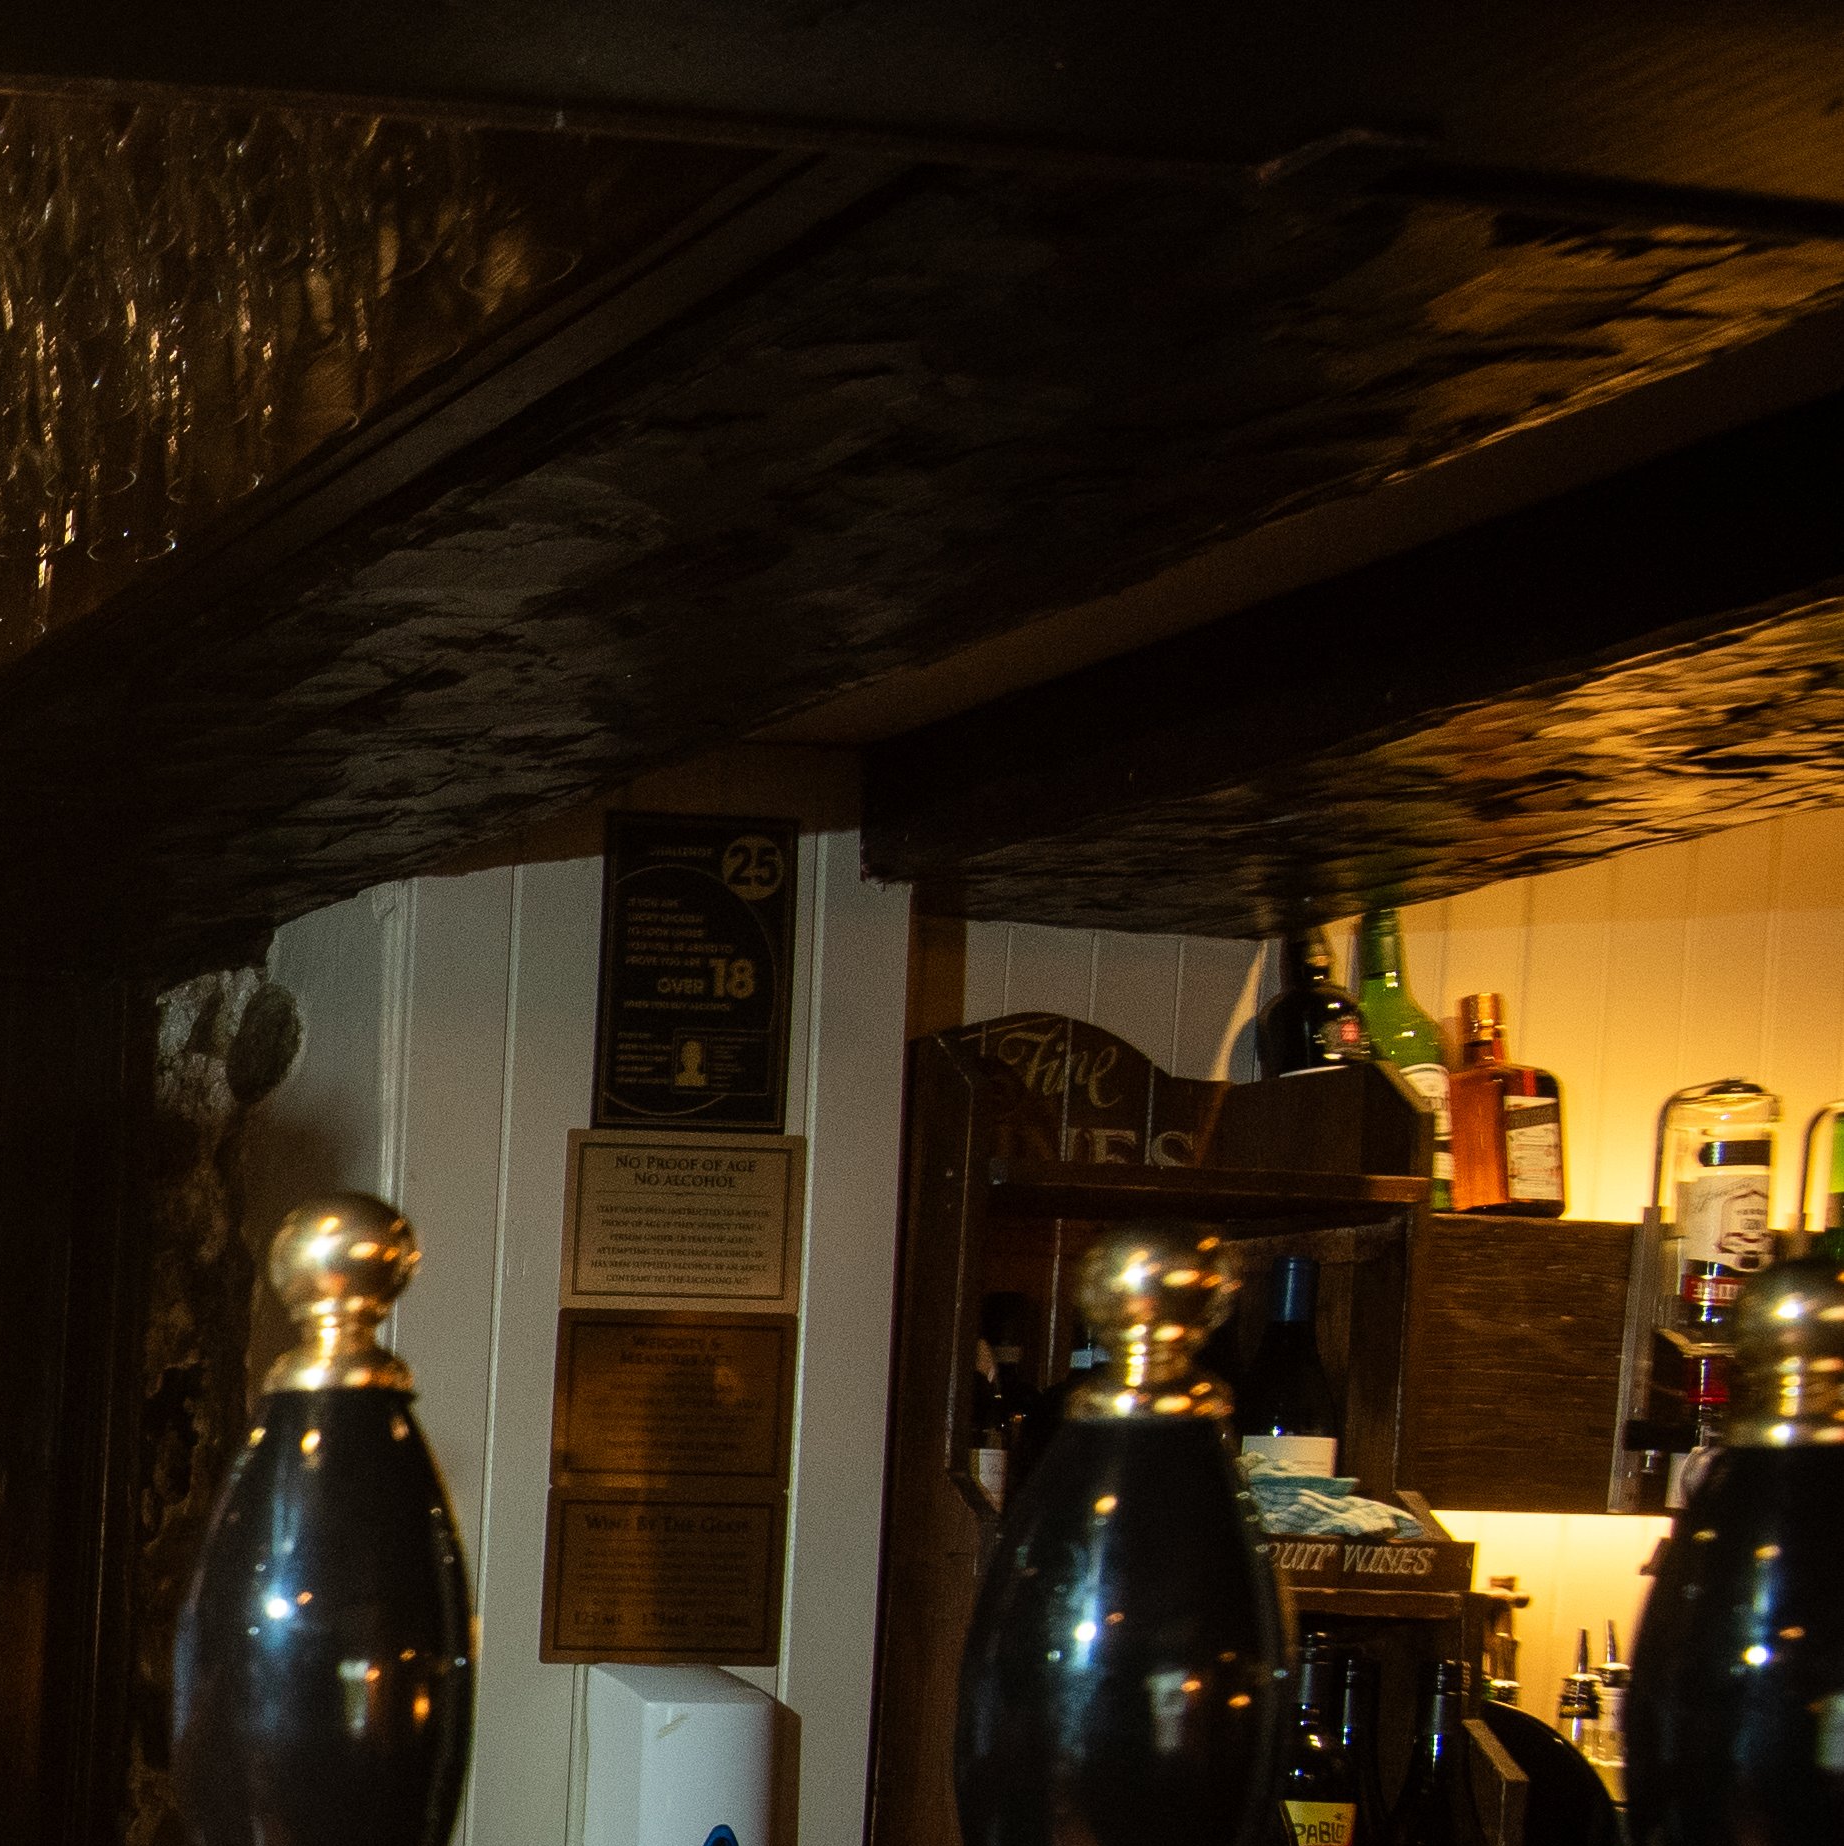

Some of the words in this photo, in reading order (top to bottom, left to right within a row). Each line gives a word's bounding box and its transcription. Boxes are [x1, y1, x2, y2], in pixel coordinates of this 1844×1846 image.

[729, 846, 777, 886] 25
[656, 977, 705, 995] OVER
[708, 958, 755, 999] 18
[997, 1021, 1124, 1109] Fine
[634, 1172, 660, 1186] NO
[664, 1173, 735, 1188] ALCOHOL
[647, 1156, 698, 1171] PROOF
[702, 1159, 722, 1171] OF
[725, 1159, 757, 1173] AGE
[1342, 1543, 1438, 1576] WINES
[1292, 1822, 1345, 1845] PABLO
